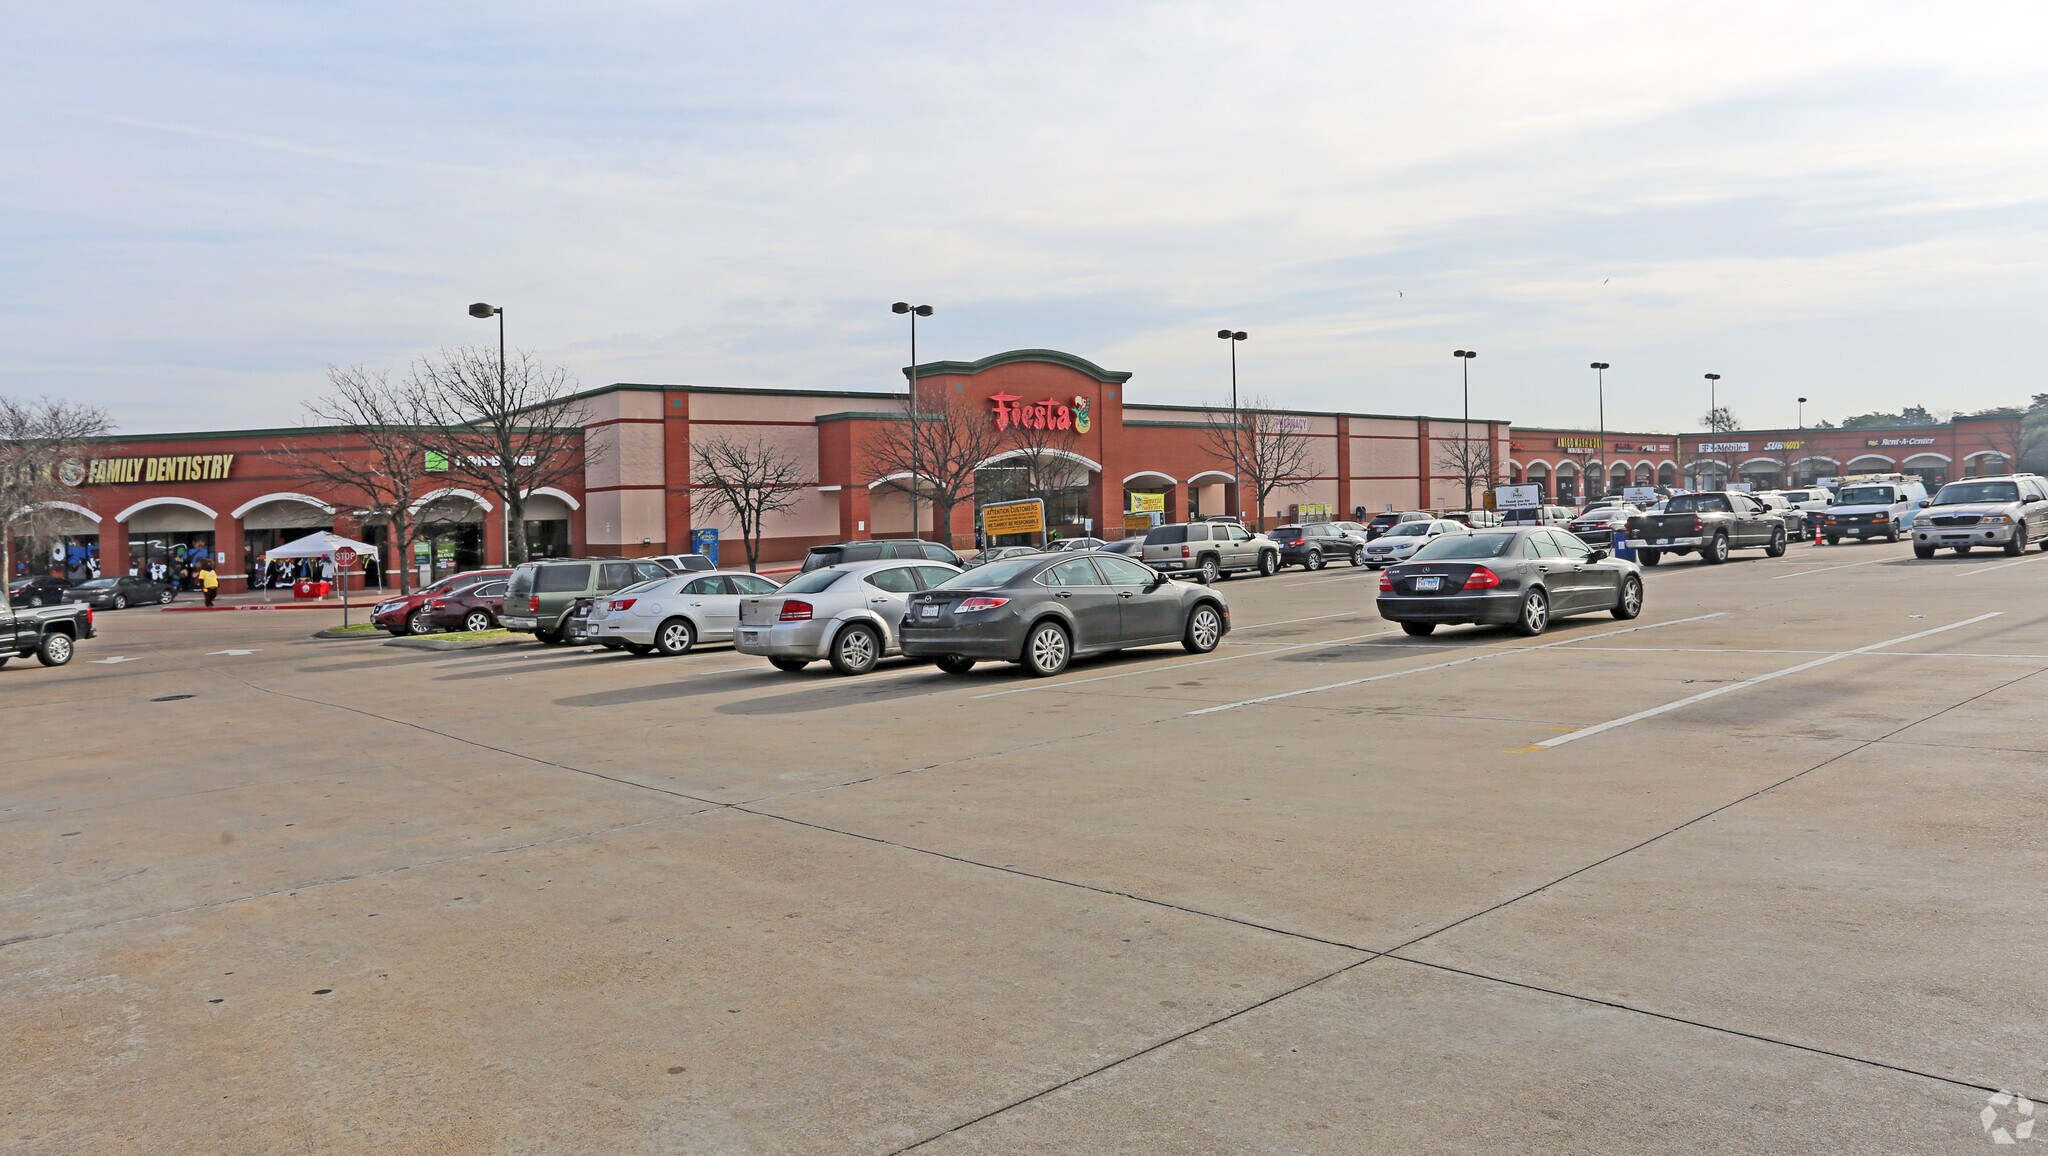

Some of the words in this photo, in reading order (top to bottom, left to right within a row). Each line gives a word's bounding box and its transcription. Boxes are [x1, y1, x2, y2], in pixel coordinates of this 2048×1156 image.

[989, 391, 1072, 432] Fiesta
[1763, 441, 1805, 451] SUBWAY
[88, 458, 144, 483] FAMILY
[145, 454, 234, 482] DENTISTRY
[335, 552, 356, 561] STOP
